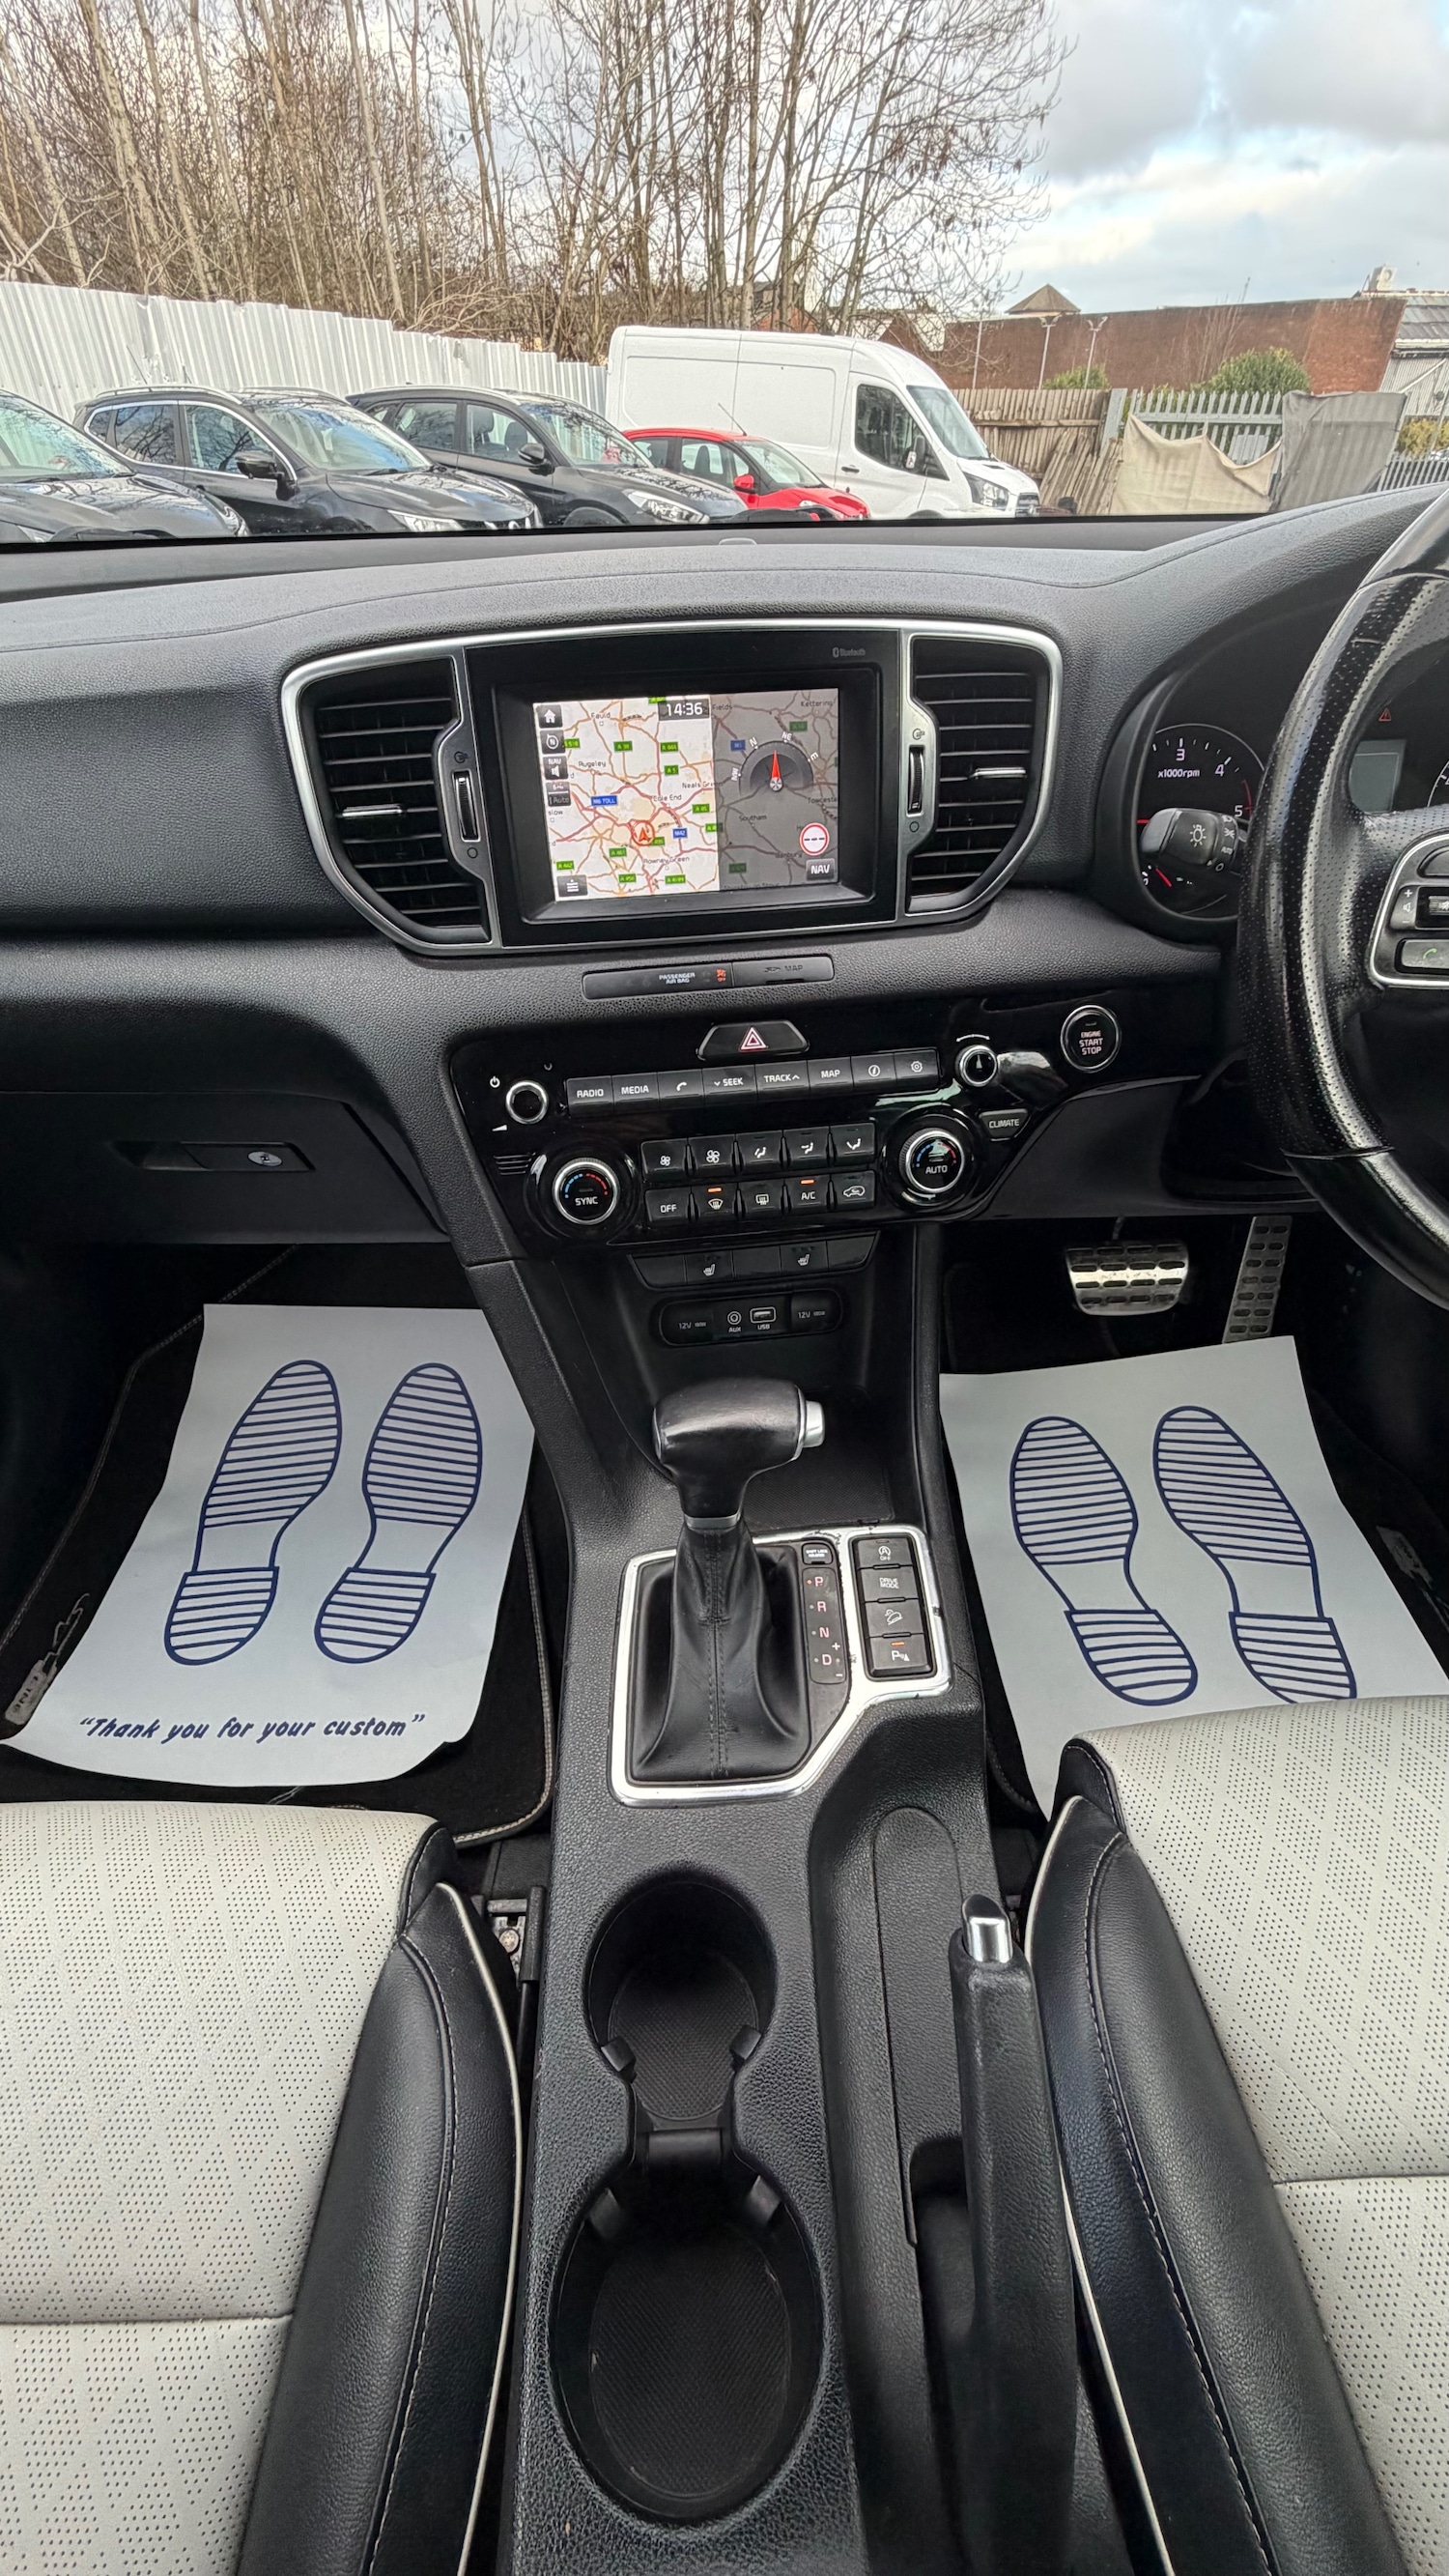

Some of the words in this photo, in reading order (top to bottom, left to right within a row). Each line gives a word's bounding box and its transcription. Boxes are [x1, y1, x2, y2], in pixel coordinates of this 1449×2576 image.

[801, 699, 834, 707] Kettering
[666, 701, 703, 717] 14:36
[750, 736, 758, 747] N
[1176, 748, 1185, 761] 3
[578, 759, 607, 768] Rugeley
[1157, 768, 1201, 779] x1000rpm
[1214, 763, 1225, 777] 4
[1235, 805, 1243, 817] 5
[810, 864, 831, 874] NAV
[659, 971, 696, 980] PASSENGER
[1080, 1030, 1101, 1039] ENGINE
[1078, 1038, 1103, 1048] START
[1081, 1046, 1102, 1055] STOP
[577, 1088, 605, 1098] RADIO
[621, 1084, 650, 1095] MEDIA
[723, 1076, 744, 1087] SEEK
[763, 1073, 792, 1083] TRACK
[820, 1068, 840, 1078] MAP
[988, 1118, 1020, 1129] CLIMATE
[924, 1164, 949, 1175] AUTO
[575, 1196, 599, 1206] SYNC
[801, 1190, 816, 1201] A/C
[660, 1203, 677, 1214] OFF
[814, 1576, 824, 1588] P
[816, 1601, 827, 1612] R
[819, 1627, 830, 1638] N
[821, 1653, 832, 1666] D
[160, 1723, 211, 1745] you
[216, 1716, 255, 1739] for
[256, 1721, 317, 1744] your
